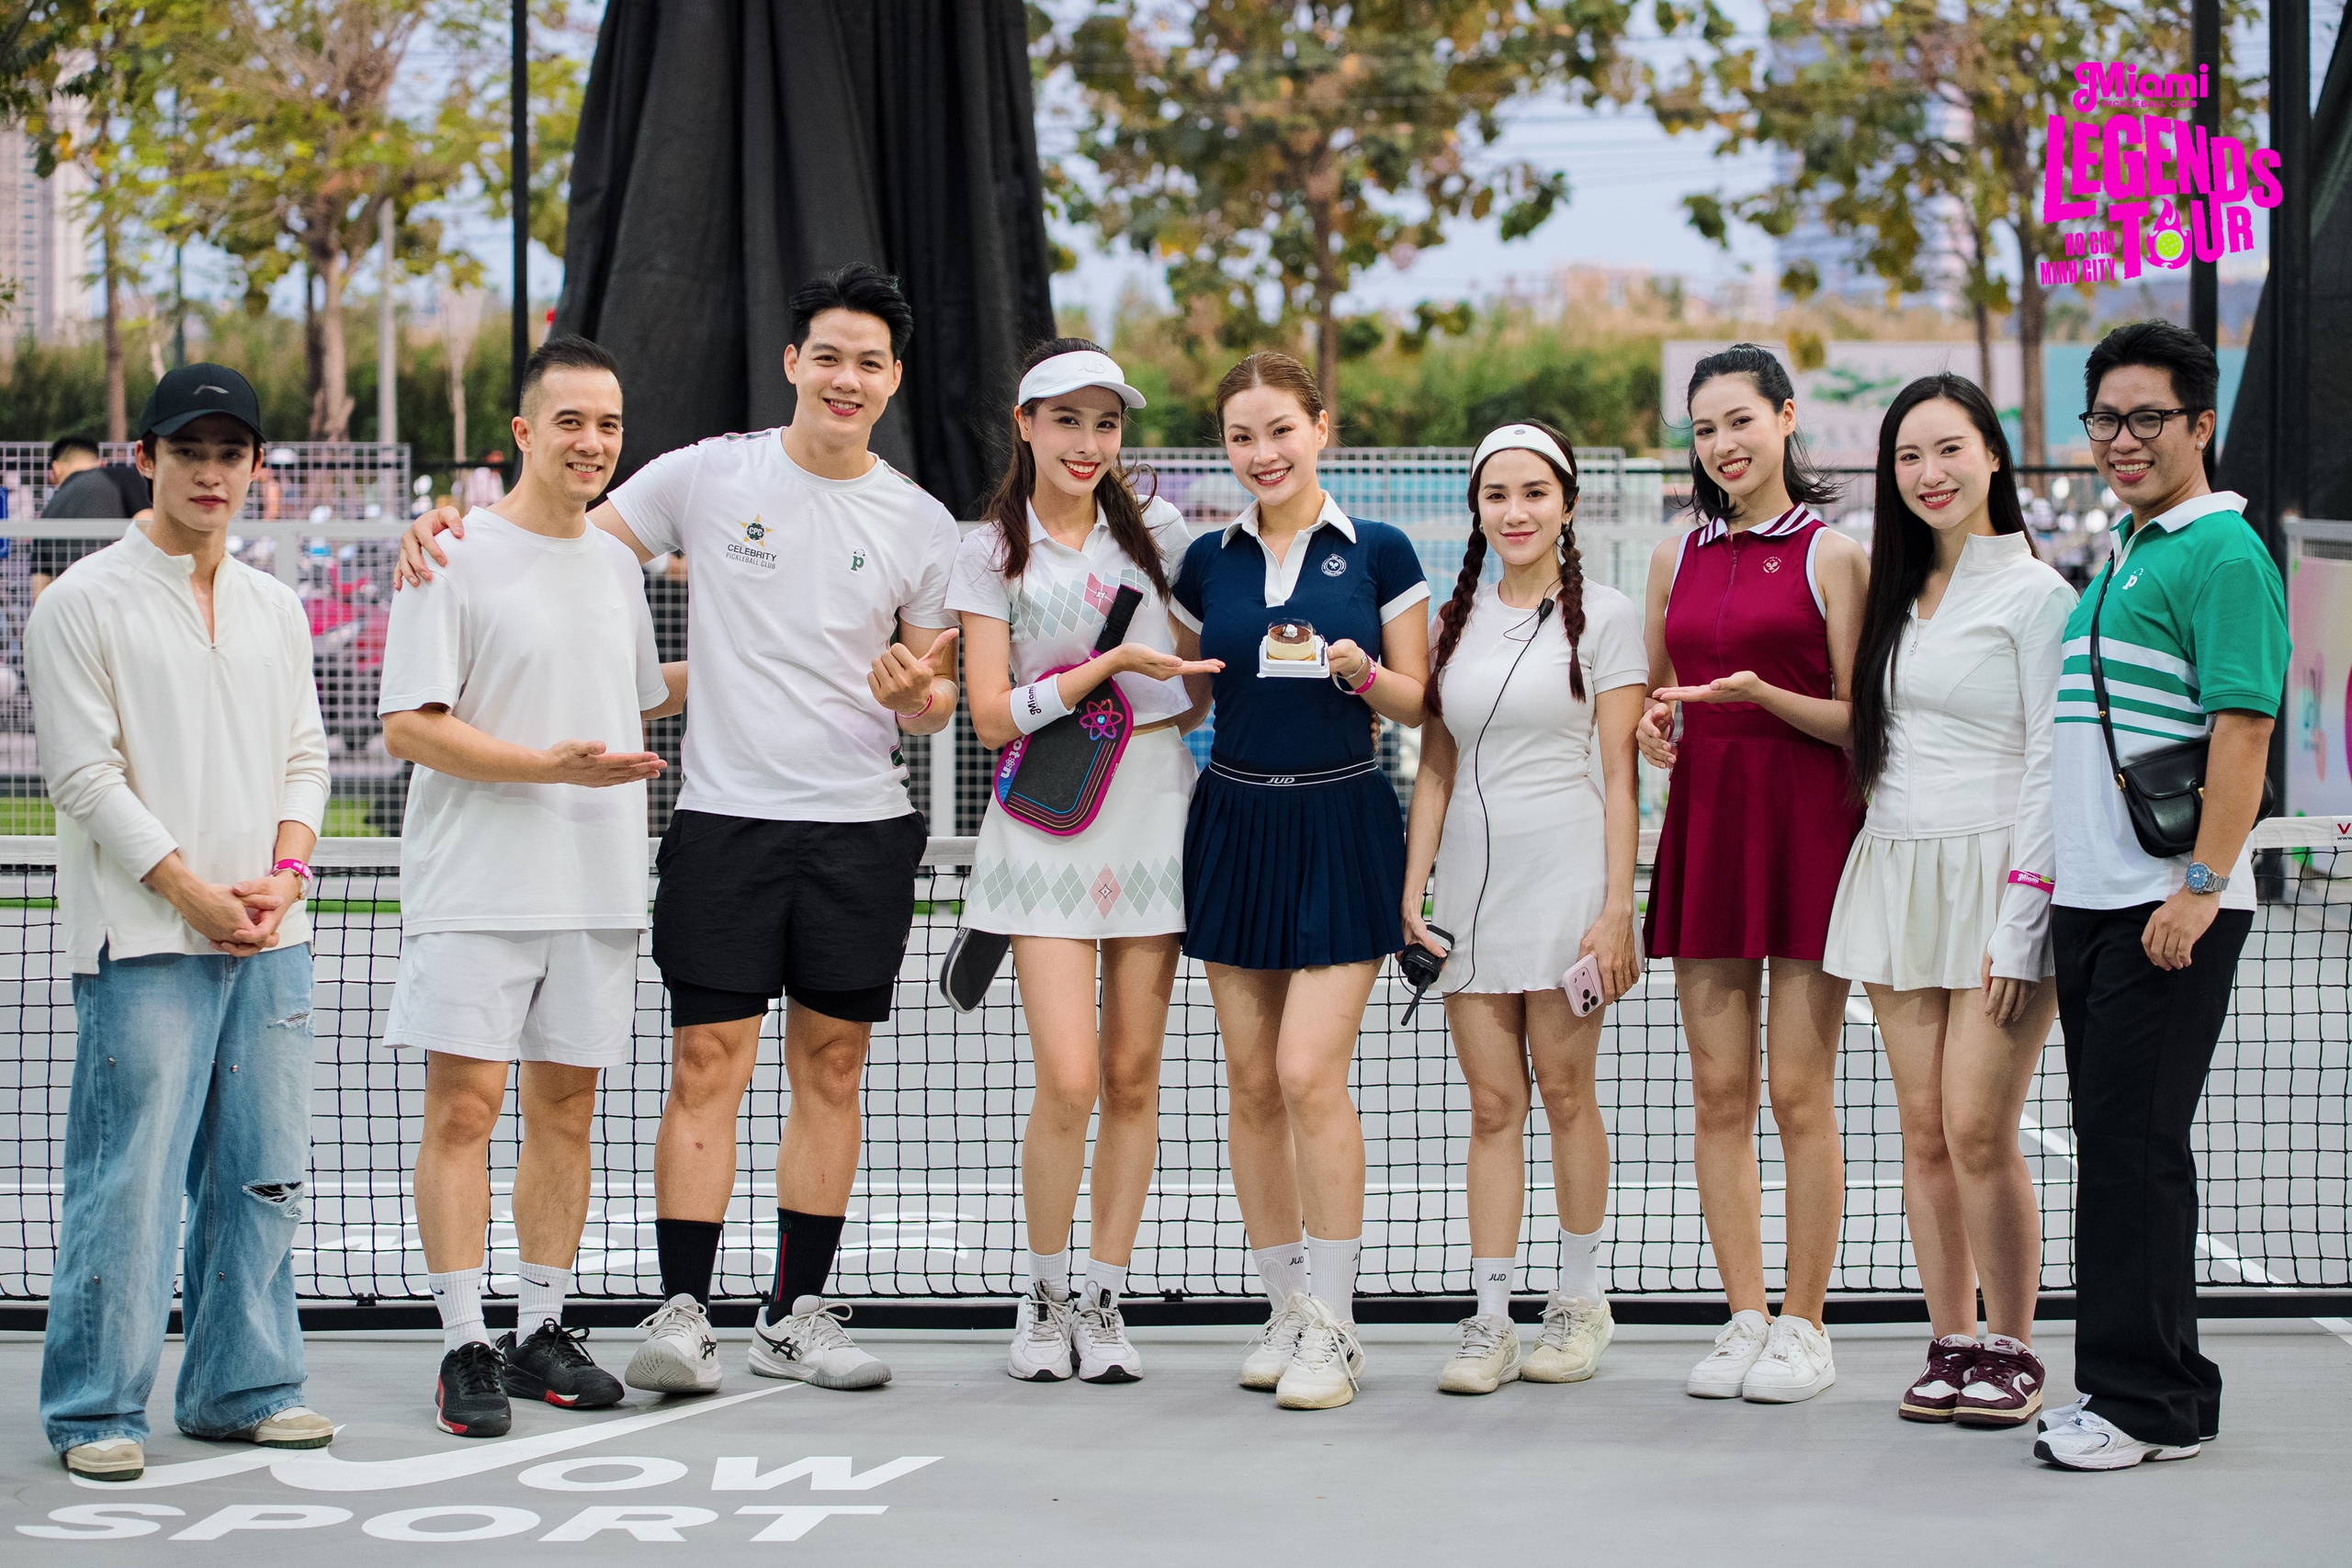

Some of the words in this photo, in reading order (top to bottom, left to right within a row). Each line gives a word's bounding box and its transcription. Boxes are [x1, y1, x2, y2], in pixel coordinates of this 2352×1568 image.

[749, 526, 763, 536] CPC
[727, 544, 777, 561] CELEBRITY
[725, 551, 759, 566] PICKLEBALL
[760, 559, 776, 570] CLUB
[1027, 685, 1042, 716] Miami
[1266, 776, 1295, 784] JUD
[1289, 1256, 1304, 1266] JUD
[1488, 1273, 1507, 1281] JUD
[15, 1503, 890, 1542] SPORT
